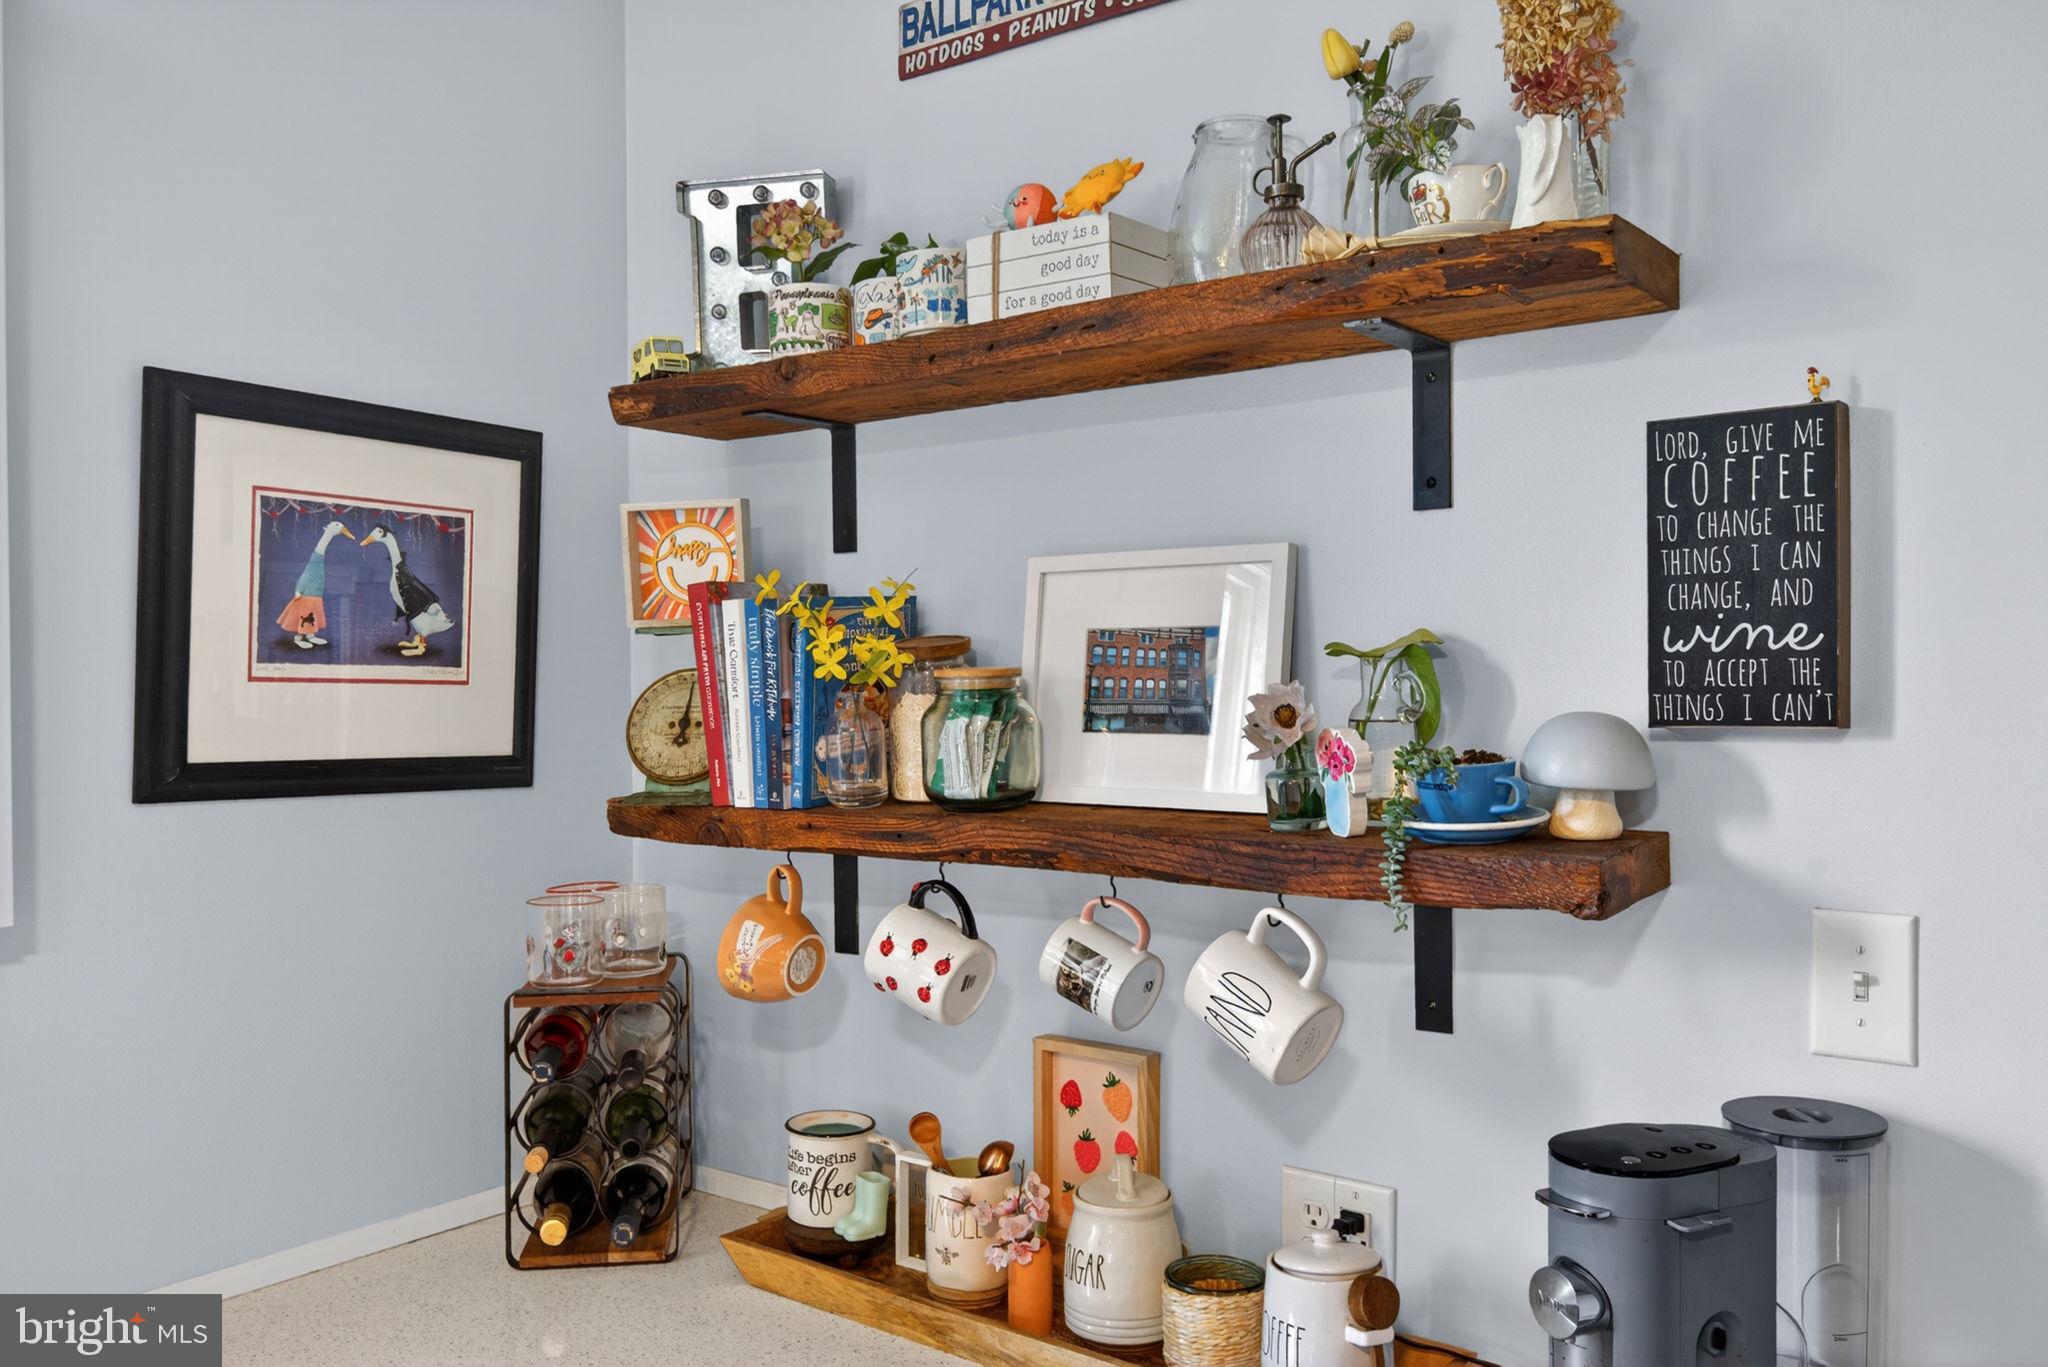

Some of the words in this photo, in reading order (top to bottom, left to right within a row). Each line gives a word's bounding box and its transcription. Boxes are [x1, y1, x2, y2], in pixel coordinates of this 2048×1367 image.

[905, 32, 985, 74] HOTDOGS
[1008, 0, 1096, 42] PEANUTS
[1032, 229, 1069, 246] today
[1073, 226, 1087, 240] is
[1091, 224, 1099, 236] a
[1041, 256, 1071, 277] good
[1076, 253, 1099, 269] day
[1005, 295, 1026, 310] for
[1030, 295, 1037, 306] a
[1041, 286, 1072, 308] good
[1076, 284, 1100, 299] day
[1655, 431, 1707, 462] LORD,
[1726, 423, 1774, 455] GIVE
[1794, 418, 1825, 449] ME
[1664, 452, 1816, 508] COFFEE
[1657, 514, 1678, 542] TO
[1697, 507, 1773, 540] CHANGE
[1793, 504, 1826, 532] THE
[1660, 545, 1731, 576] THINGS
[1751, 544, 1760, 571] I
[1780, 540, 1821, 570] CAN
[1667, 580, 1750, 611] CHANGE,
[1771, 577, 1813, 607] AND
[748, 617, 761, 653] truly
[1663, 612, 1824, 653] wine
[749, 657, 763, 707] simple
[1663, 659, 1685, 687] TO
[1704, 658, 1768, 687] ACCEPT
[1788, 657, 1822, 687] THE
[1653, 693, 1724, 721] THINGS
[1744, 693, 1752, 721] I
[1772, 689, 1834, 722] CAN'T
[806, 1151, 857, 1167] begins
[791, 1166, 856, 1217] coffee
